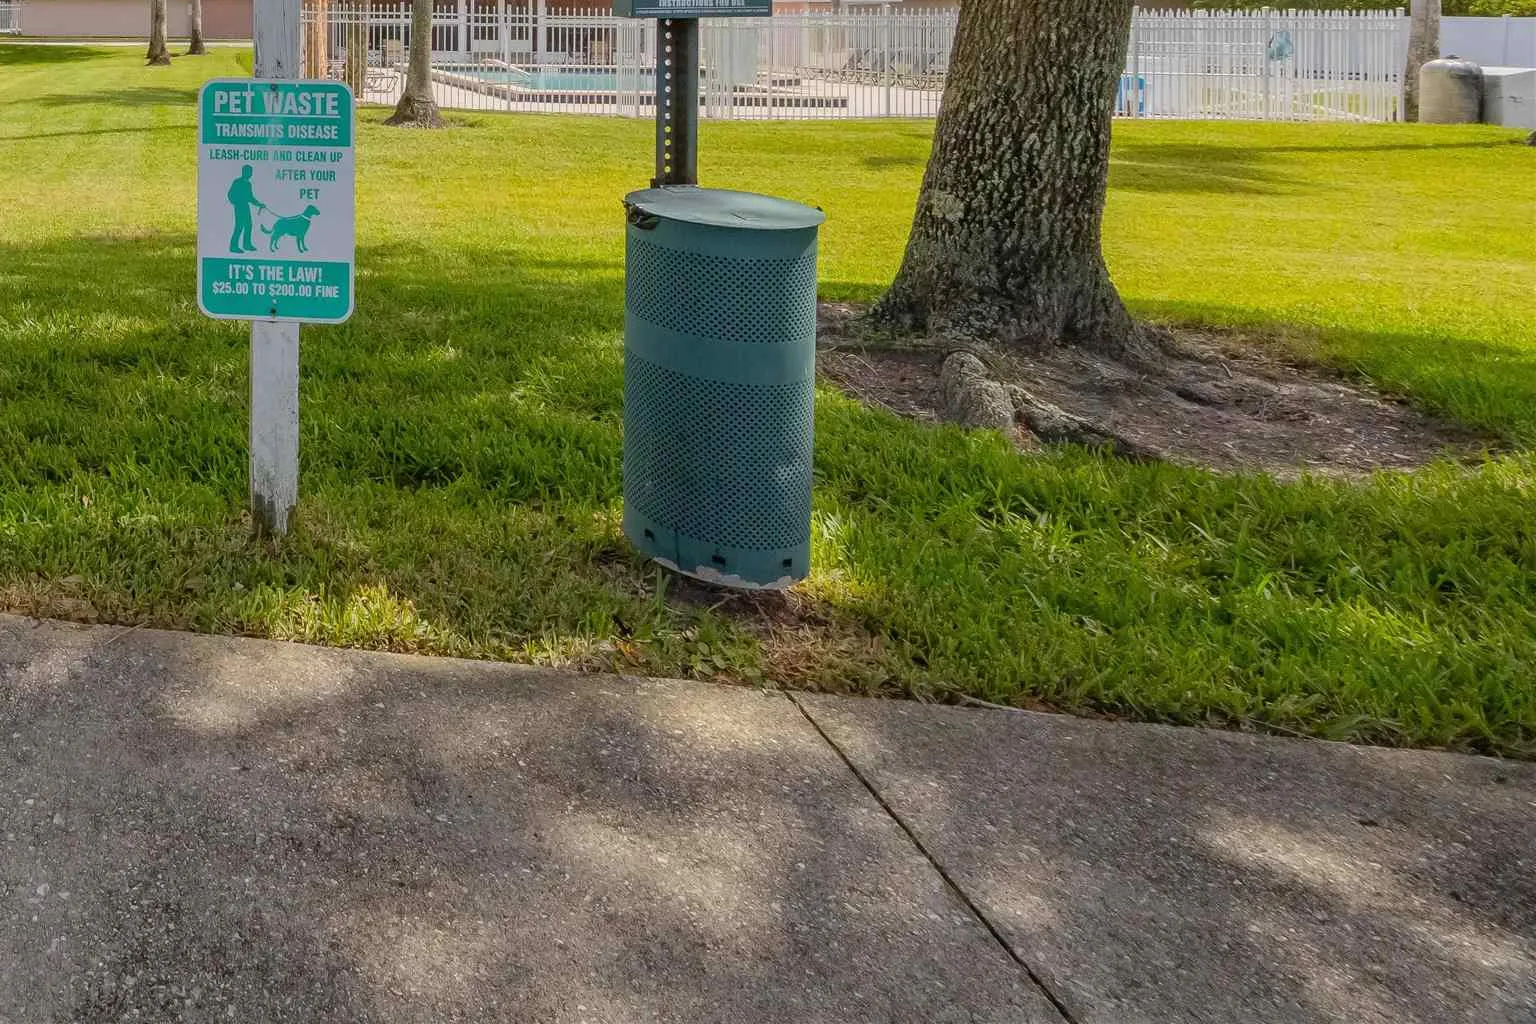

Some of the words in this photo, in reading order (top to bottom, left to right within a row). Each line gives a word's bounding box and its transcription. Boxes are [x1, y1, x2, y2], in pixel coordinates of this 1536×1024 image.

[214, 90, 255, 113] PET
[263, 92, 338, 114] WASTE
[215, 123, 284, 138] TRANSMITS
[288, 125, 338, 139] DISEASE
[273, 150, 293, 162] AND
[295, 151, 327, 163] CLEAN
[330, 151, 344, 164] UP
[275, 169, 307, 181] AFTER
[310, 169, 337, 182] YOUR
[299, 188, 321, 200] PET
[228, 263, 255, 281] IT'S
[258, 265, 284, 282] THE
[288, 266, 323, 283] LAW!
[212, 280, 249, 295] $25.00
[252, 282, 266, 296] TO
[268, 283, 313, 298] $200.00
[315, 285, 340, 298] FINE
